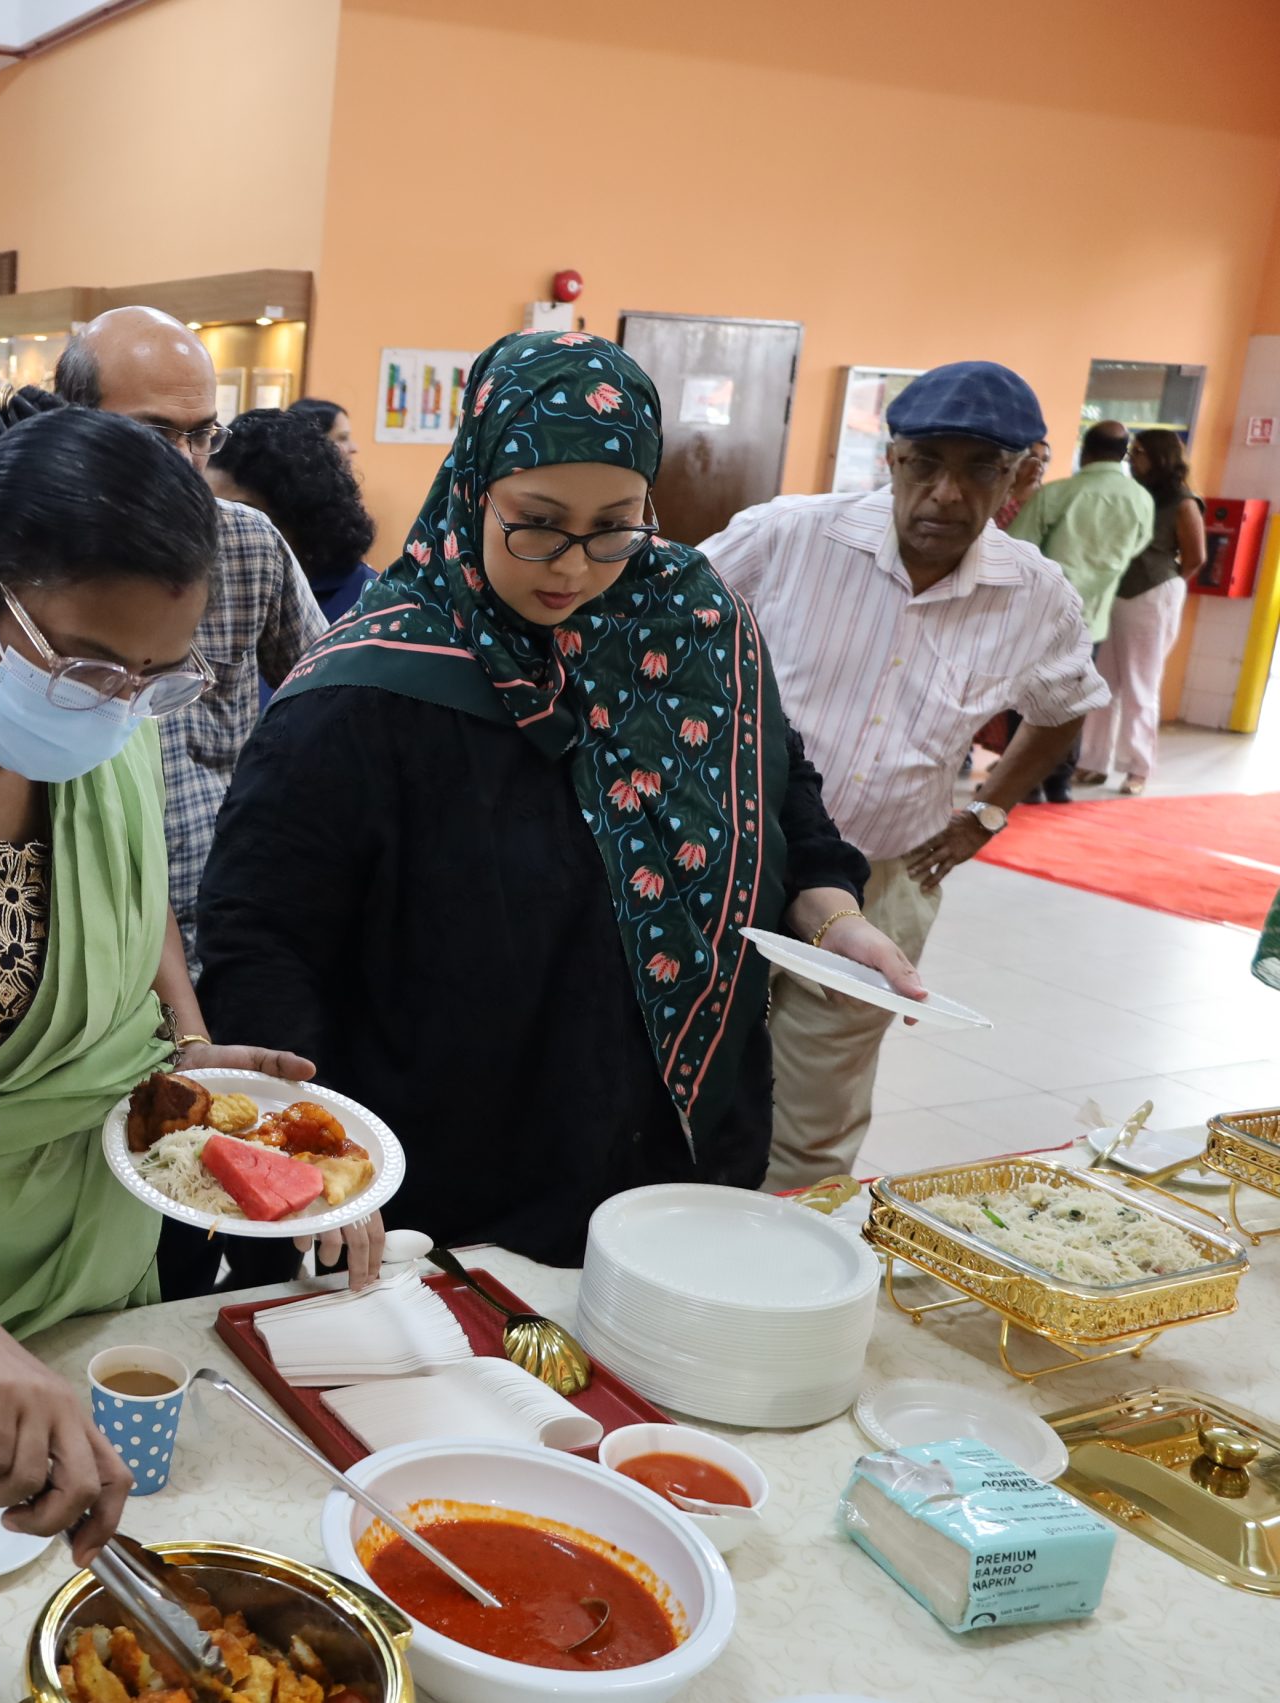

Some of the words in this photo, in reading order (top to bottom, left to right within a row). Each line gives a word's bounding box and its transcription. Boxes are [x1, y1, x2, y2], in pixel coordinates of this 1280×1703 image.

[976, 1549, 1037, 1566] PREMIUM
[974, 1563, 1033, 1578] BAMBOO
[972, 1576, 1016, 1592] NAPKIN
